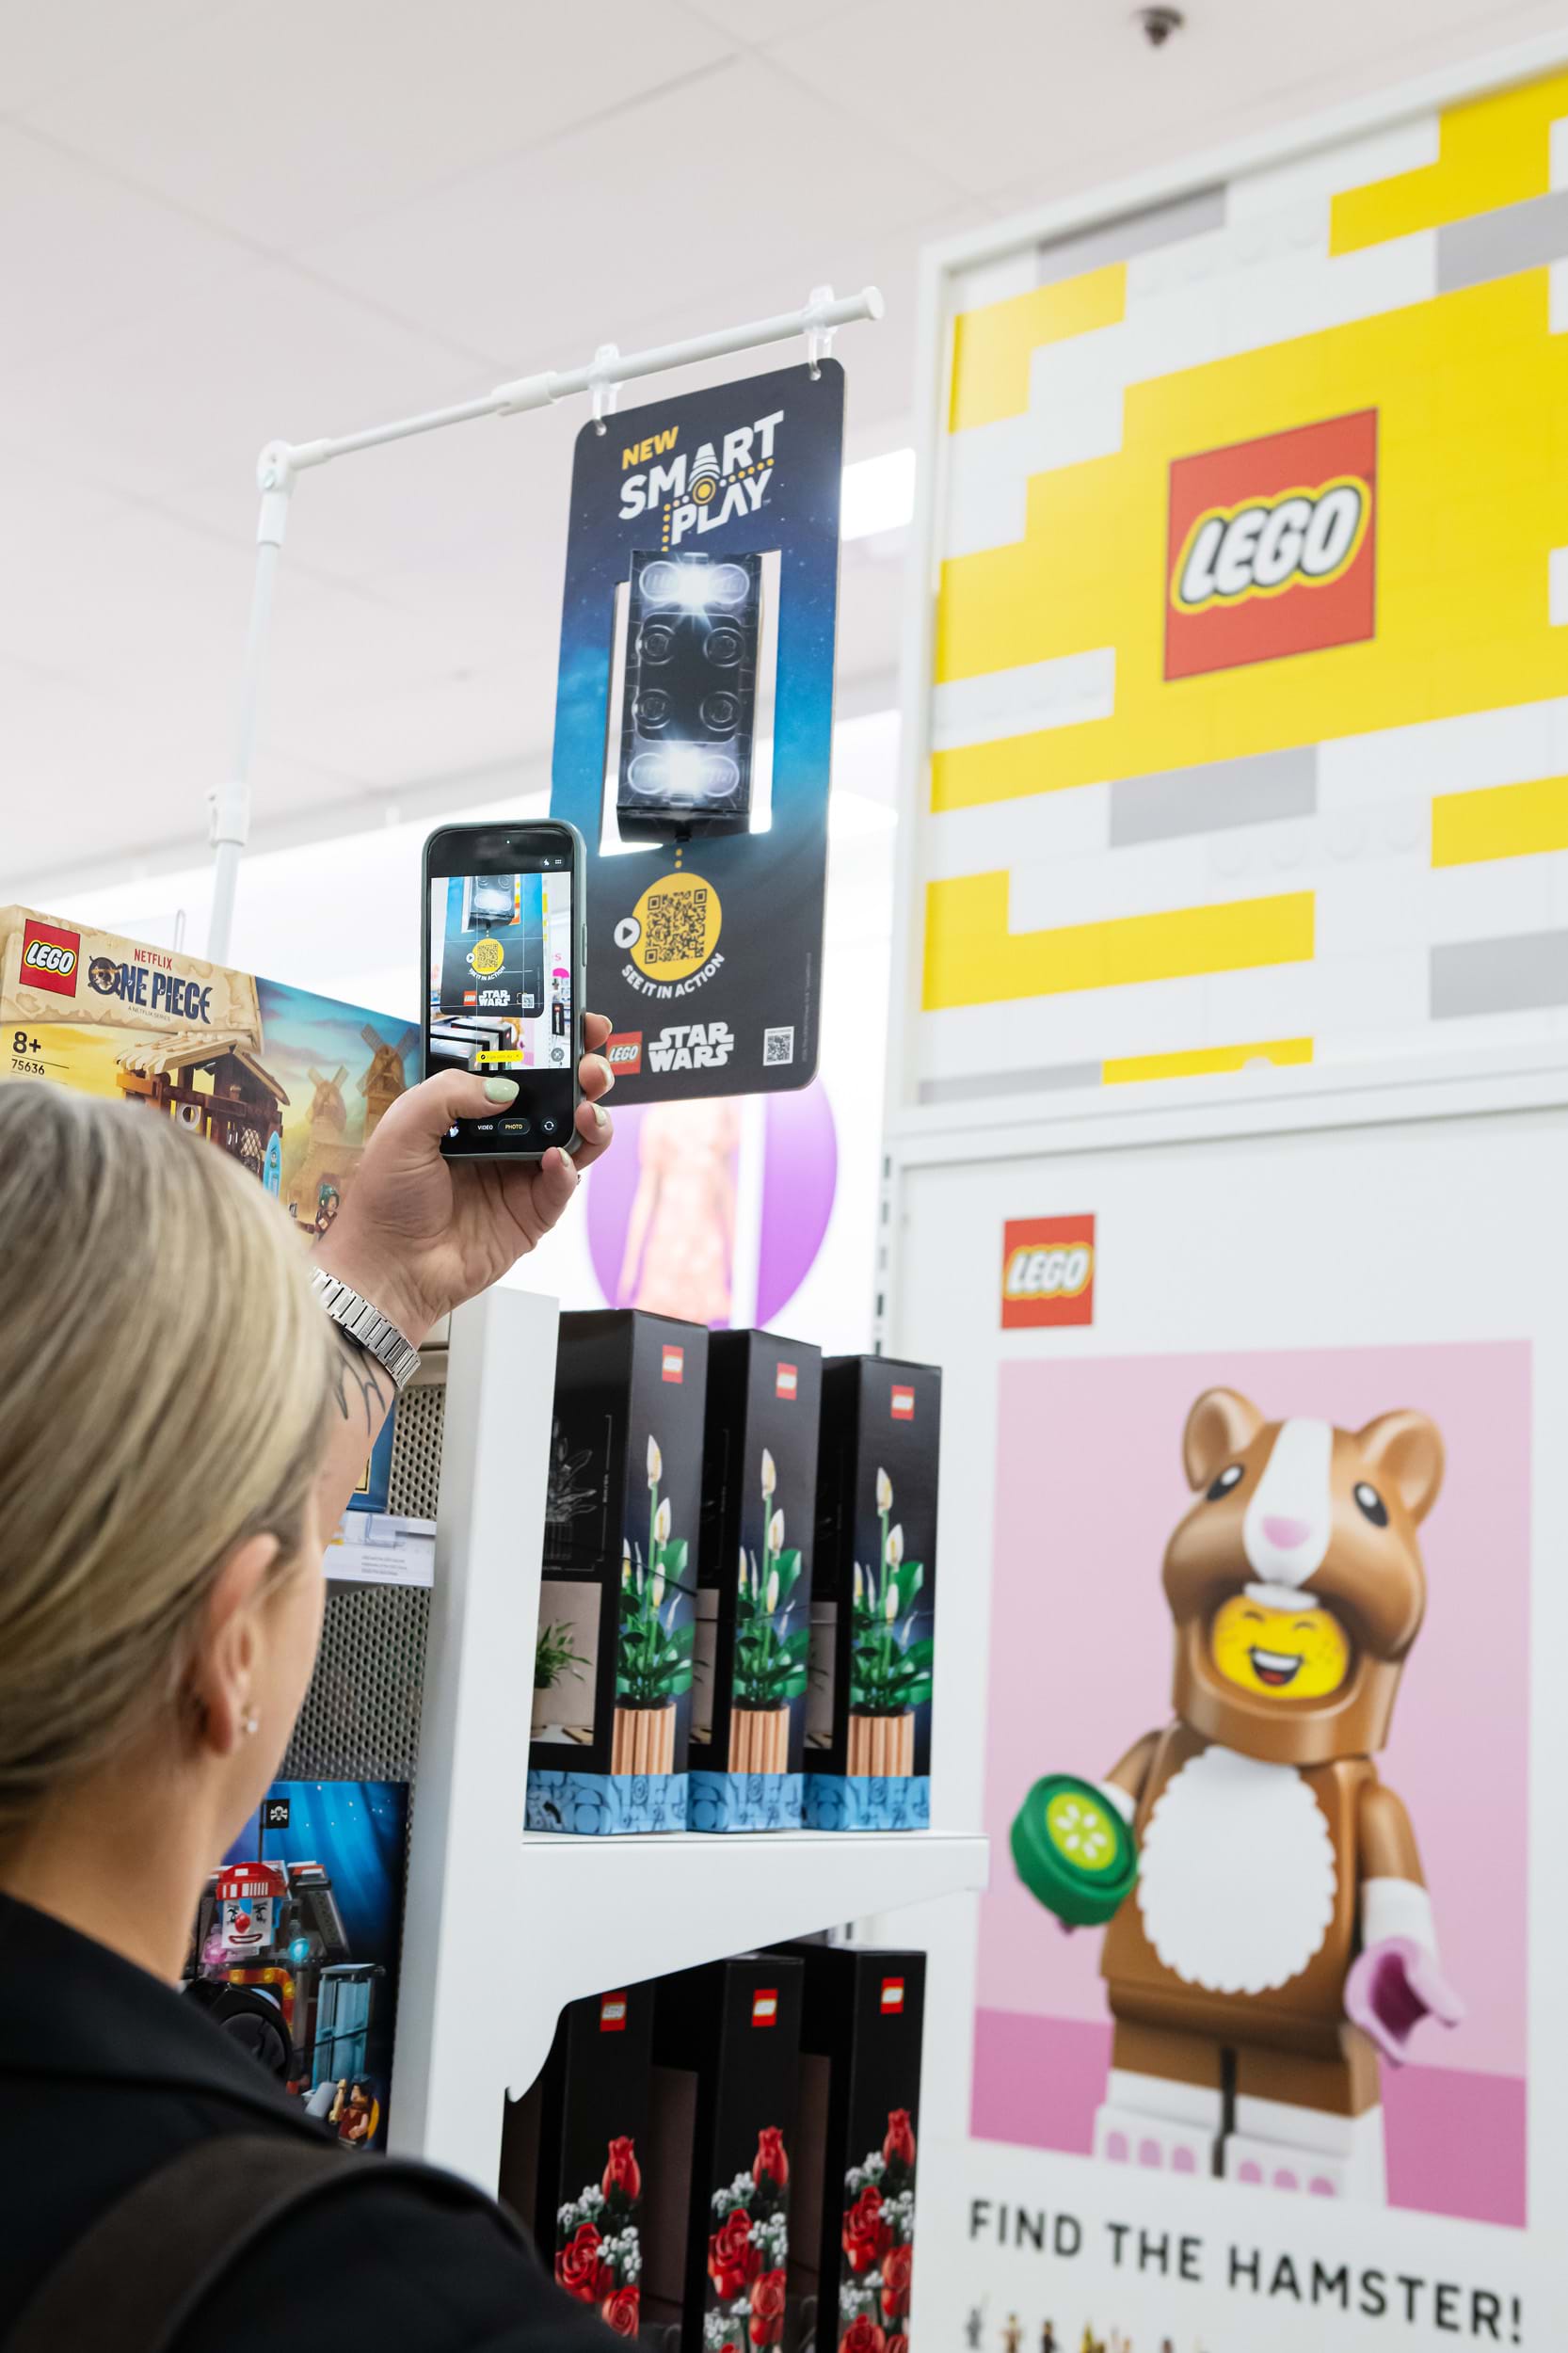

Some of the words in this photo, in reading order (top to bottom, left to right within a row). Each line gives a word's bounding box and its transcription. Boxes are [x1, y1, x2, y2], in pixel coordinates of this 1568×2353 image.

[618, 409, 784, 520] SMART
[622, 425, 679, 470] NEW
[671, 468, 773, 546] PLAY
[1178, 482, 1364, 606] LEGO
[25, 940, 76, 975] LEGO
[134, 948, 173, 970] NETFLIX
[621, 964, 645, 990] SEE
[641, 982, 657, 997] IT
[656, 985, 672, 999] IN
[675, 952, 725, 998] ACTION
[151, 970, 213, 1025] PIECE
[479, 989, 510, 999] STAR
[479, 998, 510, 1006] WARS
[12, 1031, 41, 1054] 8+
[648, 1021, 735, 1050] STAR
[10, 1058, 45, 1076] 75636
[608, 1044, 640, 1063] LEGO
[648, 1042, 735, 1073] WARS
[1006, 1247, 1090, 1296] LEGO
[969, 2199, 1083, 2257] FIND
[1106, 2222, 1204, 2282] THE
[1227, 2245, 1524, 2345] HAMSTER!
